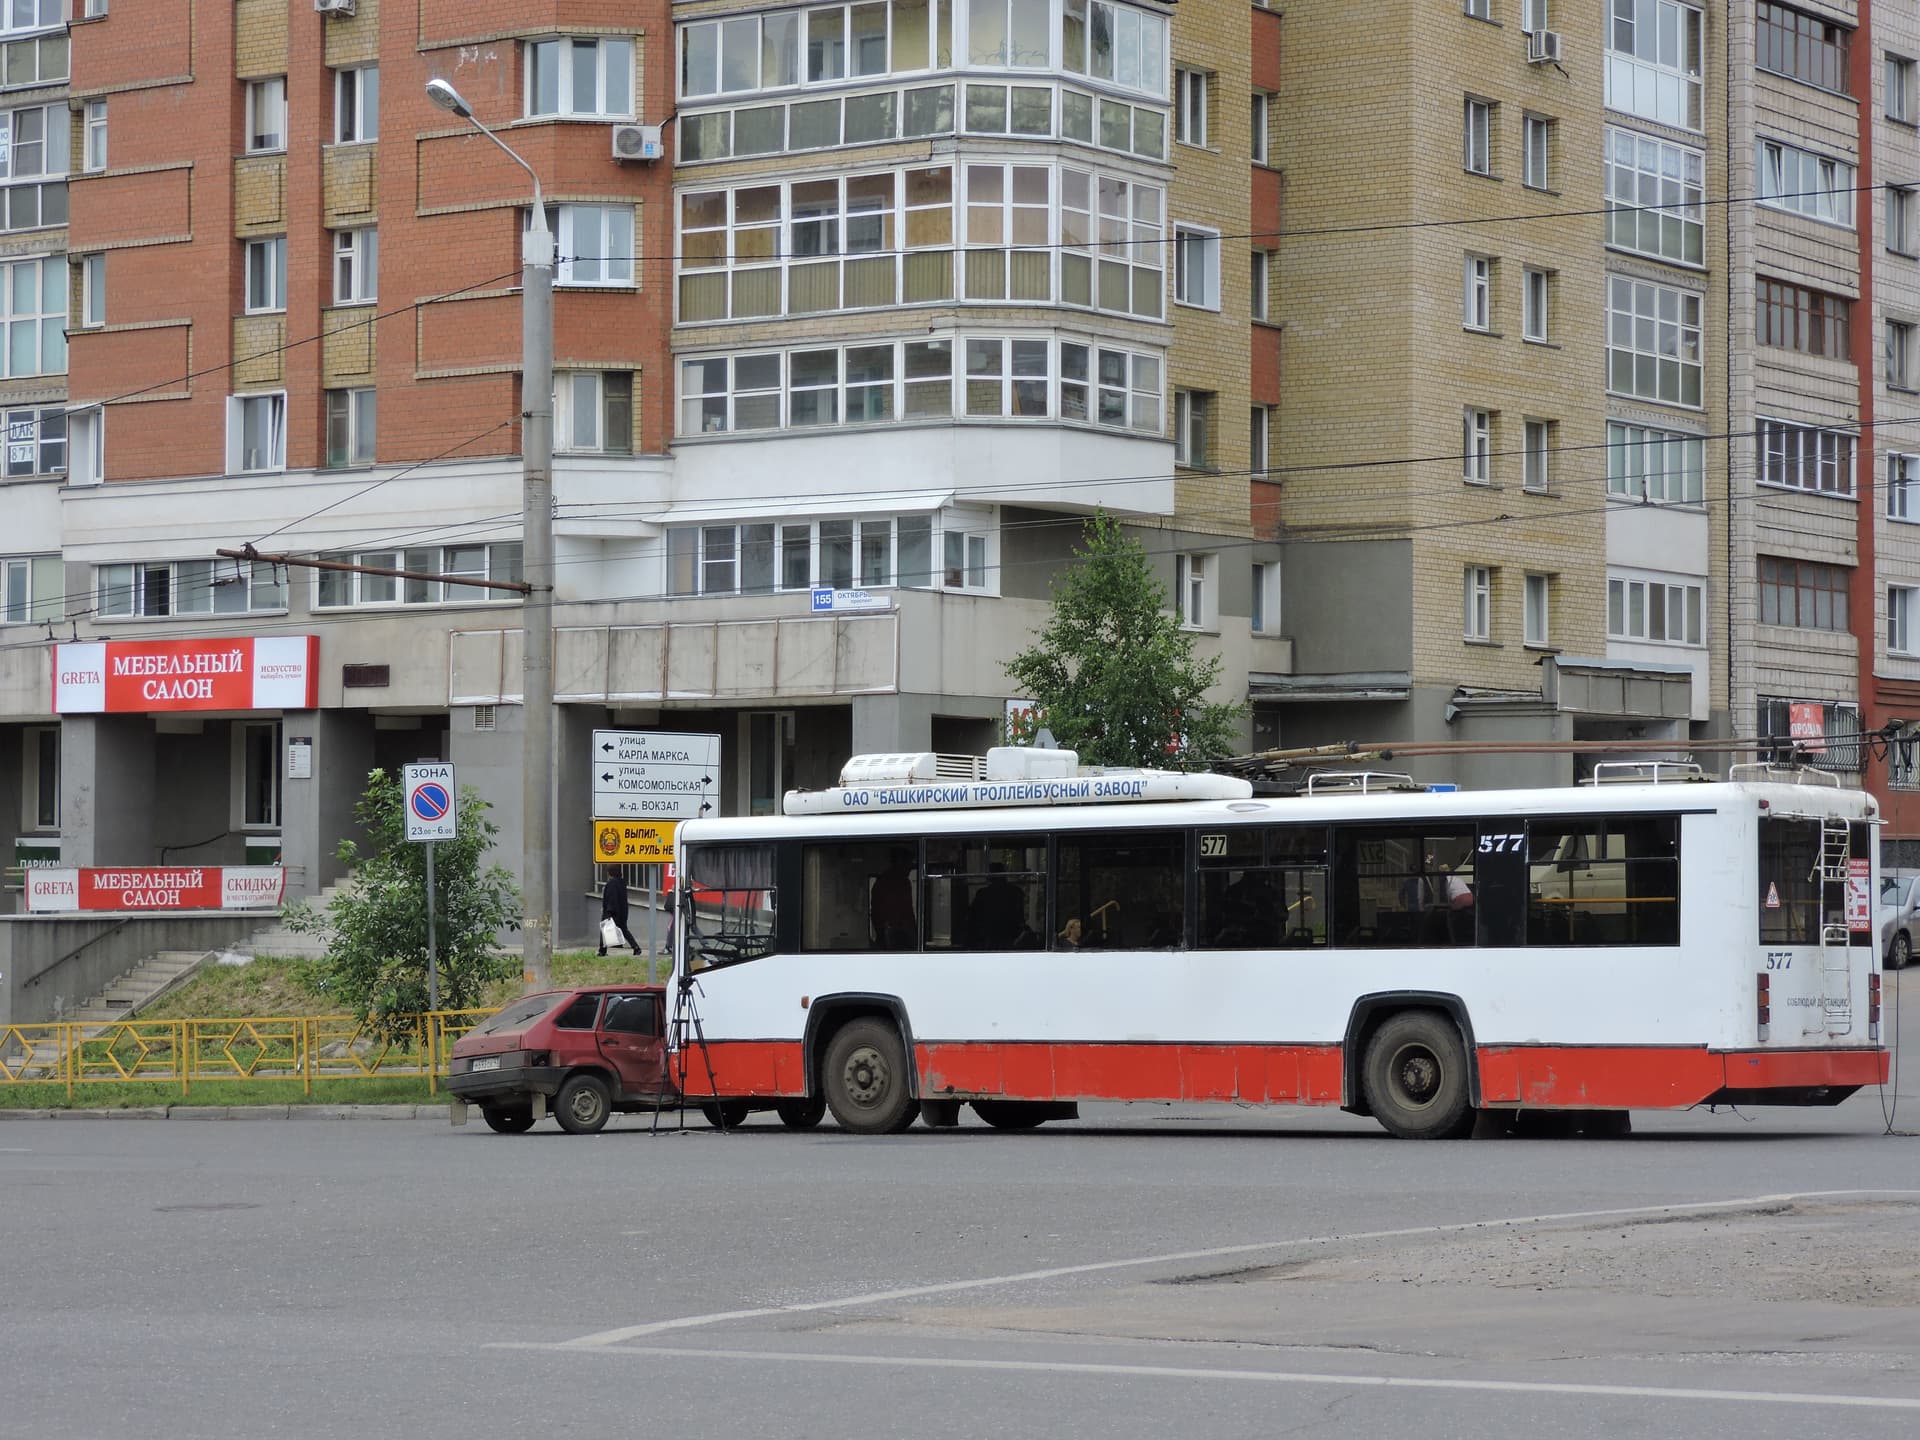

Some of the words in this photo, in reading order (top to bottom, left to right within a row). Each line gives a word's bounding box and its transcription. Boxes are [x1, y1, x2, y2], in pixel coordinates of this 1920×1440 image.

[815, 594, 832, 605] 155
[113, 649, 243, 676] МЕБЕЛЬНЫЙ
[61, 671, 100, 685] GRETA
[143, 679, 213, 700] САЛОН
[619, 736, 646, 747] улица
[618, 750, 649, 760] КАРЛА
[651, 750, 690, 761] МАРКСА
[411, 768, 448, 779] ЗОНА
[619, 766, 646, 777] улица
[618, 779, 701, 791] КОМСОМОЛЬСКАЯ
[843, 791, 869, 806] ОАО
[972, 780, 1090, 801] ТРОЛЛЕЙБУСНЫЙ
[641, 801, 679, 811] ВОКЗАЛ
[624, 845, 636, 855] ЗА
[639, 845, 660, 856] РУЛЬ
[662, 845, 674, 855] НЕ
[1201, 836, 1227, 855] 577
[1478, 834, 1524, 853] 577
[94, 869, 203, 889] МЕБЕЛЬНЫЙ
[227, 878, 278, 893] СКИДКИ
[34, 881, 74, 895] GRETA
[122, 890, 181, 906] САЛОН
[1766, 952, 1793, 970] 577
[1817, 997, 1849, 1008] ДСТАНЦИЮ
